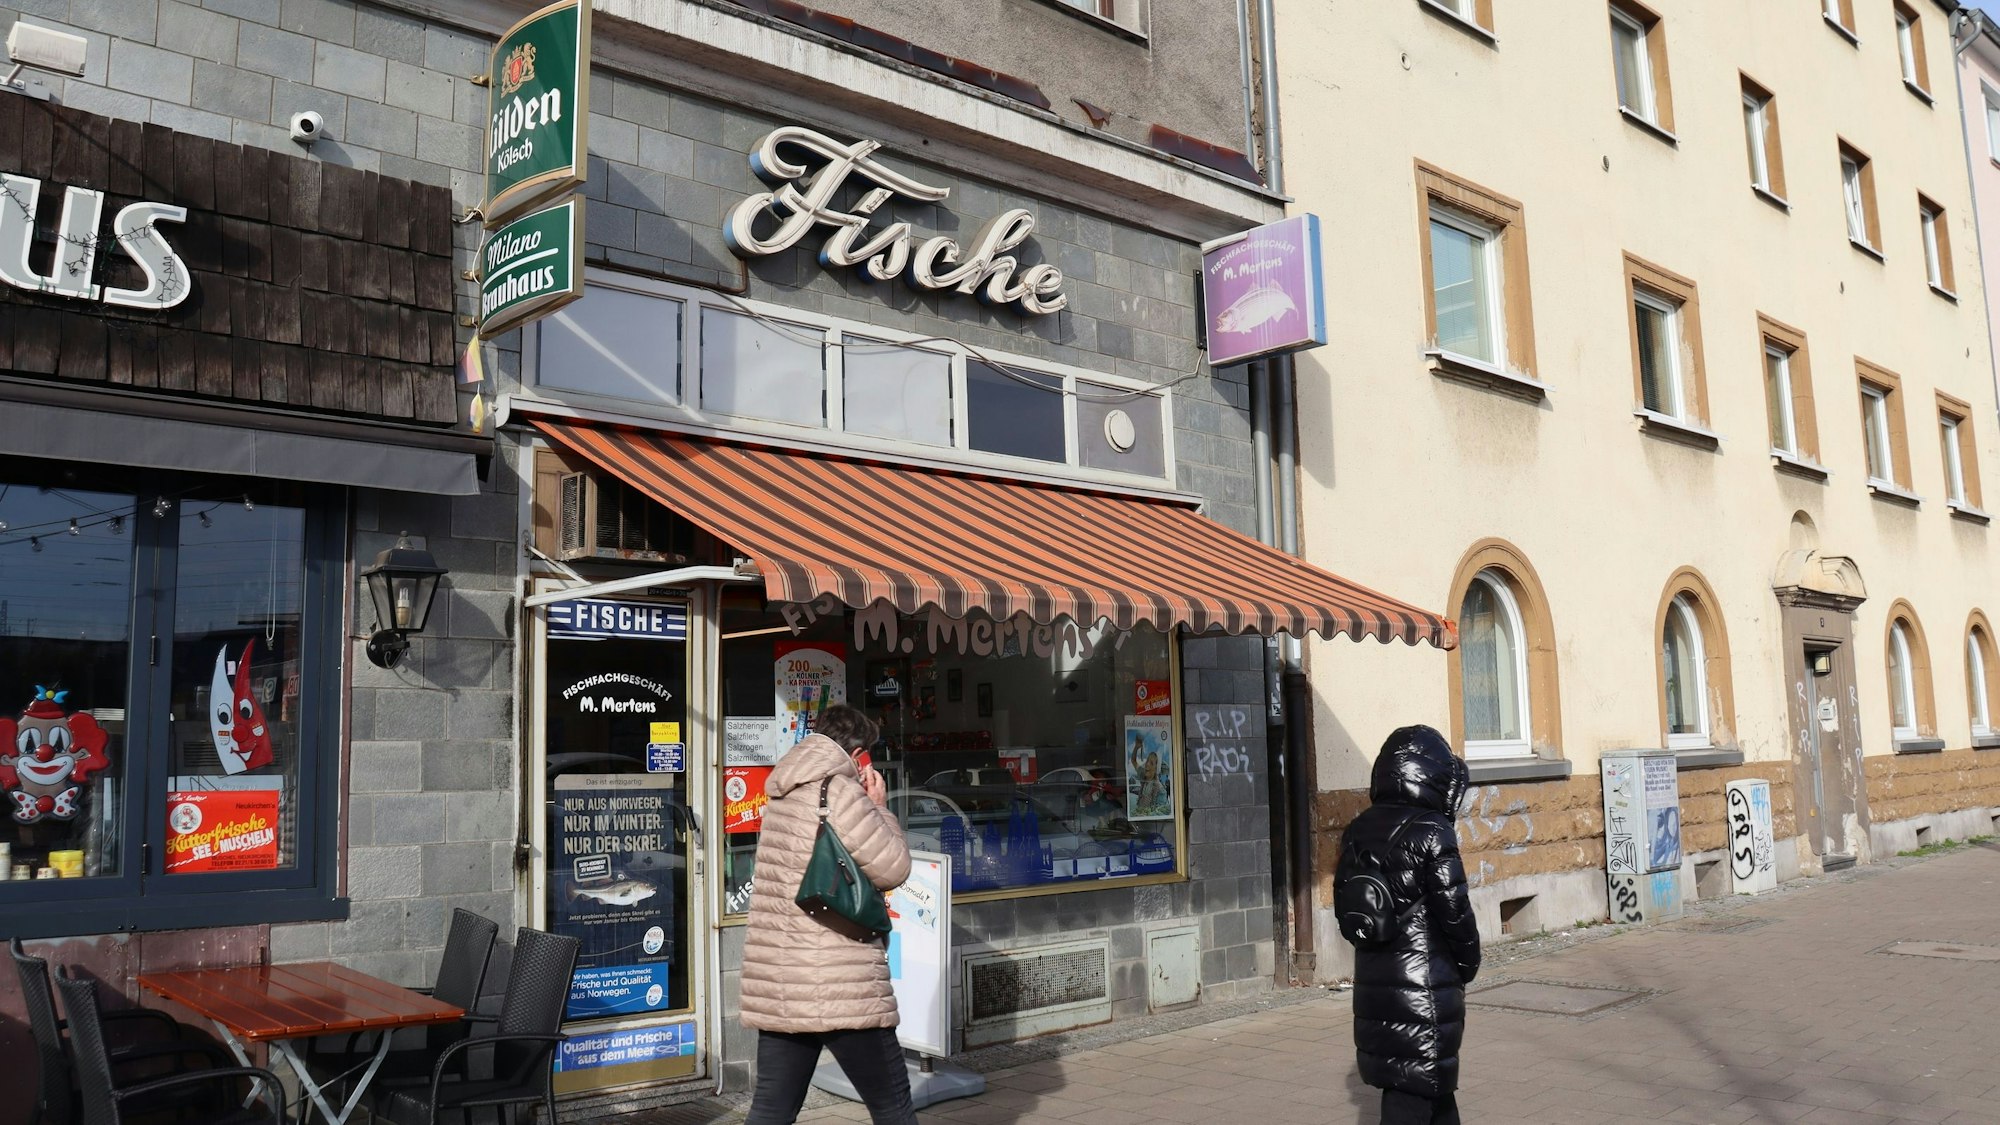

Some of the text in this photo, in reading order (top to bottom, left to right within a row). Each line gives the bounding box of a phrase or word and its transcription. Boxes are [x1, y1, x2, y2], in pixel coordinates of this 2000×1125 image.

[489, 87, 562, 159] Gilden
[497, 137, 533, 174] Kölsch
[723, 125, 1069, 315] Fische
[487, 229, 542, 273] Milano
[1210, 239, 1296, 275] FISCHFACHGESCHÄFT
[1223, 257, 1283, 281] M. Mertens
[481, 263, 555, 321] Brauhaus
[576, 604, 663, 632] FISCHE
[853, 600, 914, 654] M.
[926, 600, 1094, 660] Mertens
[788, 660, 810, 672] 200
[796, 672, 820, 680] KÖLNER
[562, 672, 673, 702] FISCHFACHGESCHÄFT
[580, 696, 656, 714] M. Mertens
[727, 721, 769, 731] Salzheringe
[728, 732, 759, 741] Salzfilets
[728, 742, 763, 752] Salzrogen
[728, 753, 773, 762] Salzmilchner
[564, 797, 664, 811] NUR AUS NORWEGEN.
[724, 792, 768, 817] Kutterfri
[741, 809, 754, 822] SEE
[166, 813, 267, 854] Kutterfrische
[564, 814, 664, 832] NUR IM WINTER.
[192, 828, 274, 860] SEE MUSCHELN
[564, 834, 664, 854] NUR DER SKREI.
[728, 874, 755, 911] Fris
[570, 988, 631, 1000] aus Norwegen.
[571, 975, 652, 990] Frische und Qualität
[563, 1031, 673, 1054] Qualität und Frische
[577, 1046, 655, 1065] aus dem Meer
